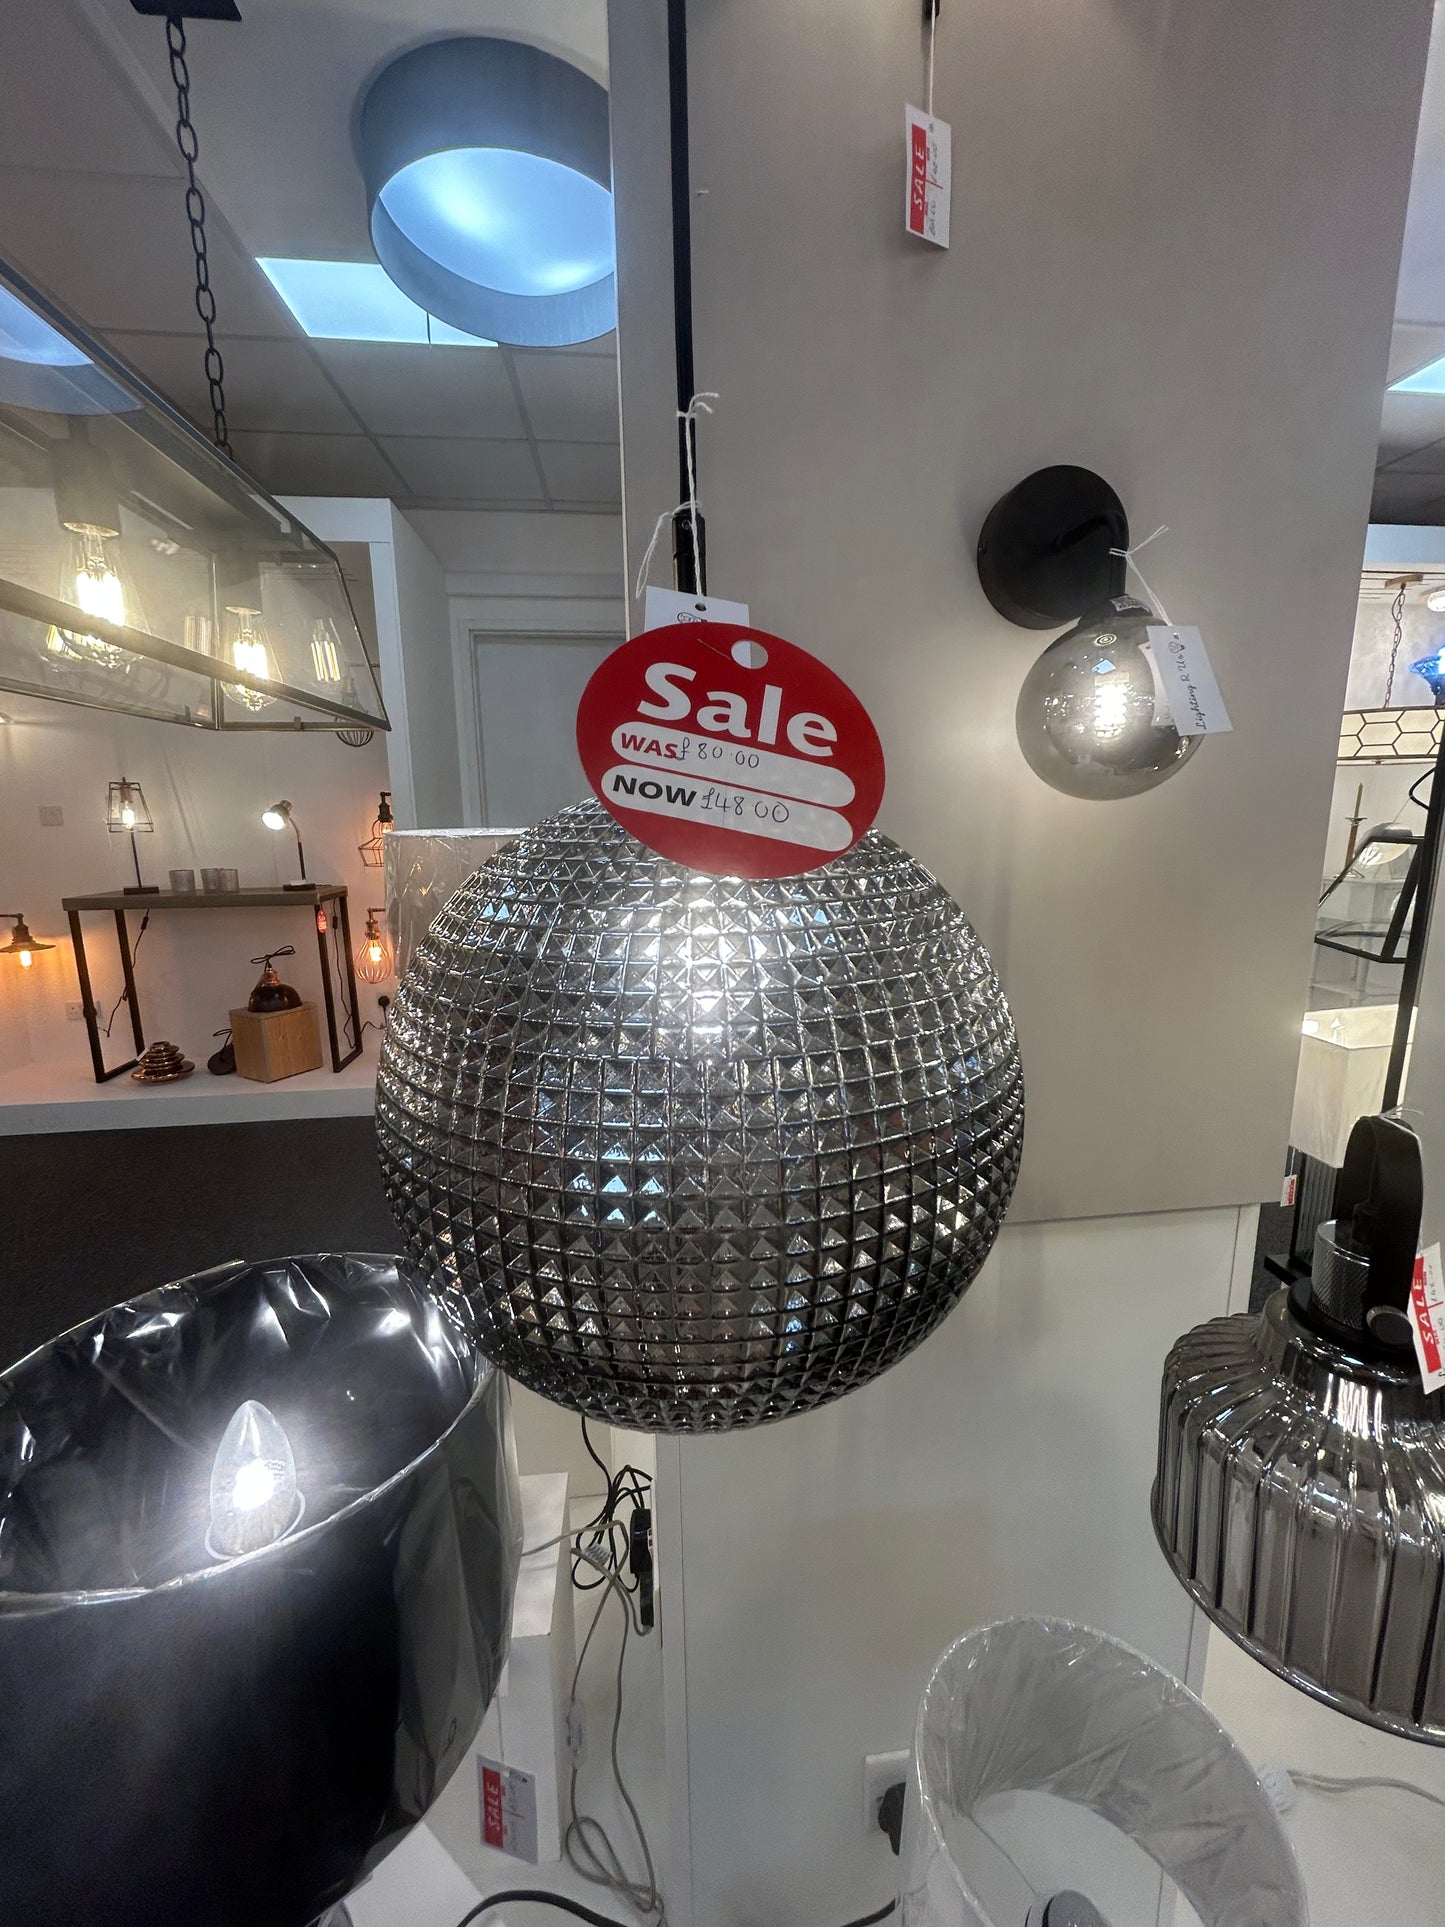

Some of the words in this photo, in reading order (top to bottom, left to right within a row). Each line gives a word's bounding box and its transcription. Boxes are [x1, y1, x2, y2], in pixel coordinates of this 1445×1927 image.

[914, 143, 924, 211] SALE
[1176, 654, 1186, 671] Us
[1180, 673, 1190, 682] R
[636, 662, 838, 757] Sale
[1187, 684, 1207, 730] Lighting
[621, 732, 679, 759] WAS
[612, 774, 698, 807] NOW
[1412, 1278, 1435, 1345] SALE
[486, 1782, 500, 1832] SALE
